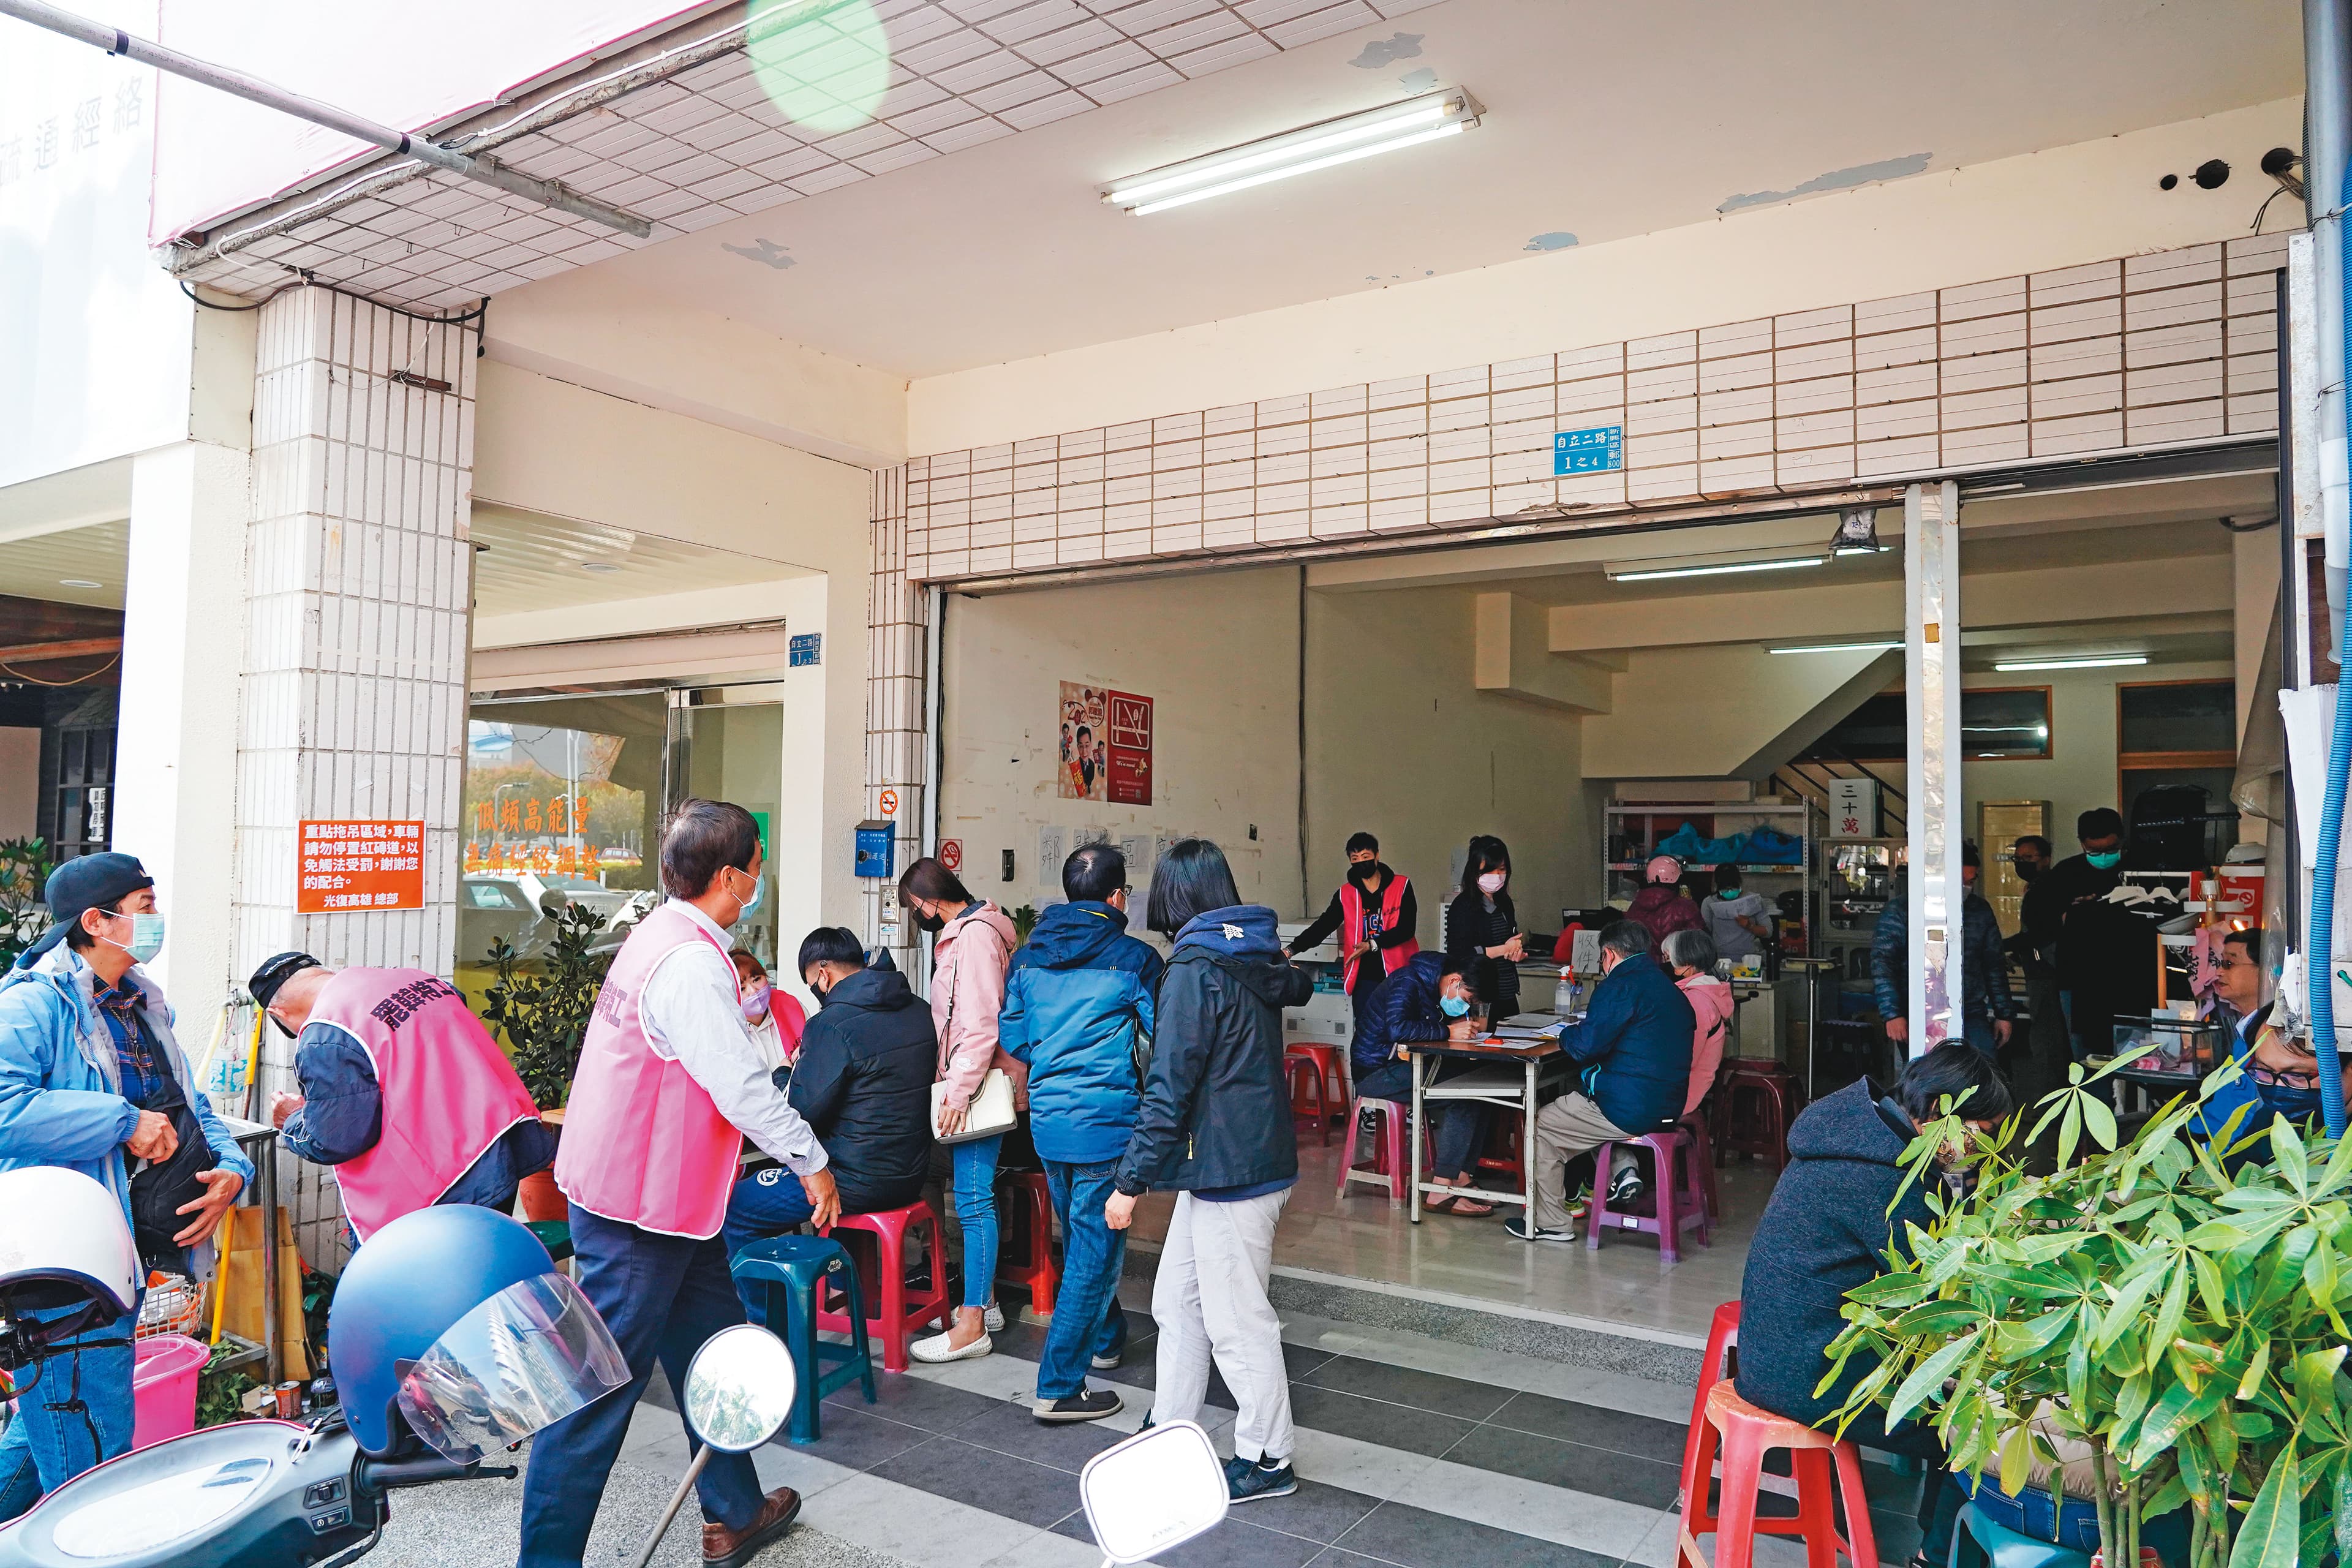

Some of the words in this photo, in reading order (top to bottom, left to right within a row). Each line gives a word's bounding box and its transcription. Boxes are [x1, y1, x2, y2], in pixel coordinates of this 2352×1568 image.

[1558, 431, 1607, 449] 自立二路
[1610, 428, 1619, 448] 新興區
[791, 638, 813, 649] 自立二路
[477, 796, 592, 834] 低頻高能量
[1841, 785, 1859, 834] 三十萬
[304, 824, 419, 839] 重點拖吊區域，車輛
[304, 840, 419, 856] 請勿停置紅磚道，以
[304, 857, 418, 872] 免觸法受罰，謝謝您
[464, 842, 601, 881] 無痛經絡調整
[304, 875, 352, 890] 的配合。
[323, 894, 372, 908] 光復高雄
[374, 892, 399, 905] 總部
[1577, 933, 1595, 970] 收件
